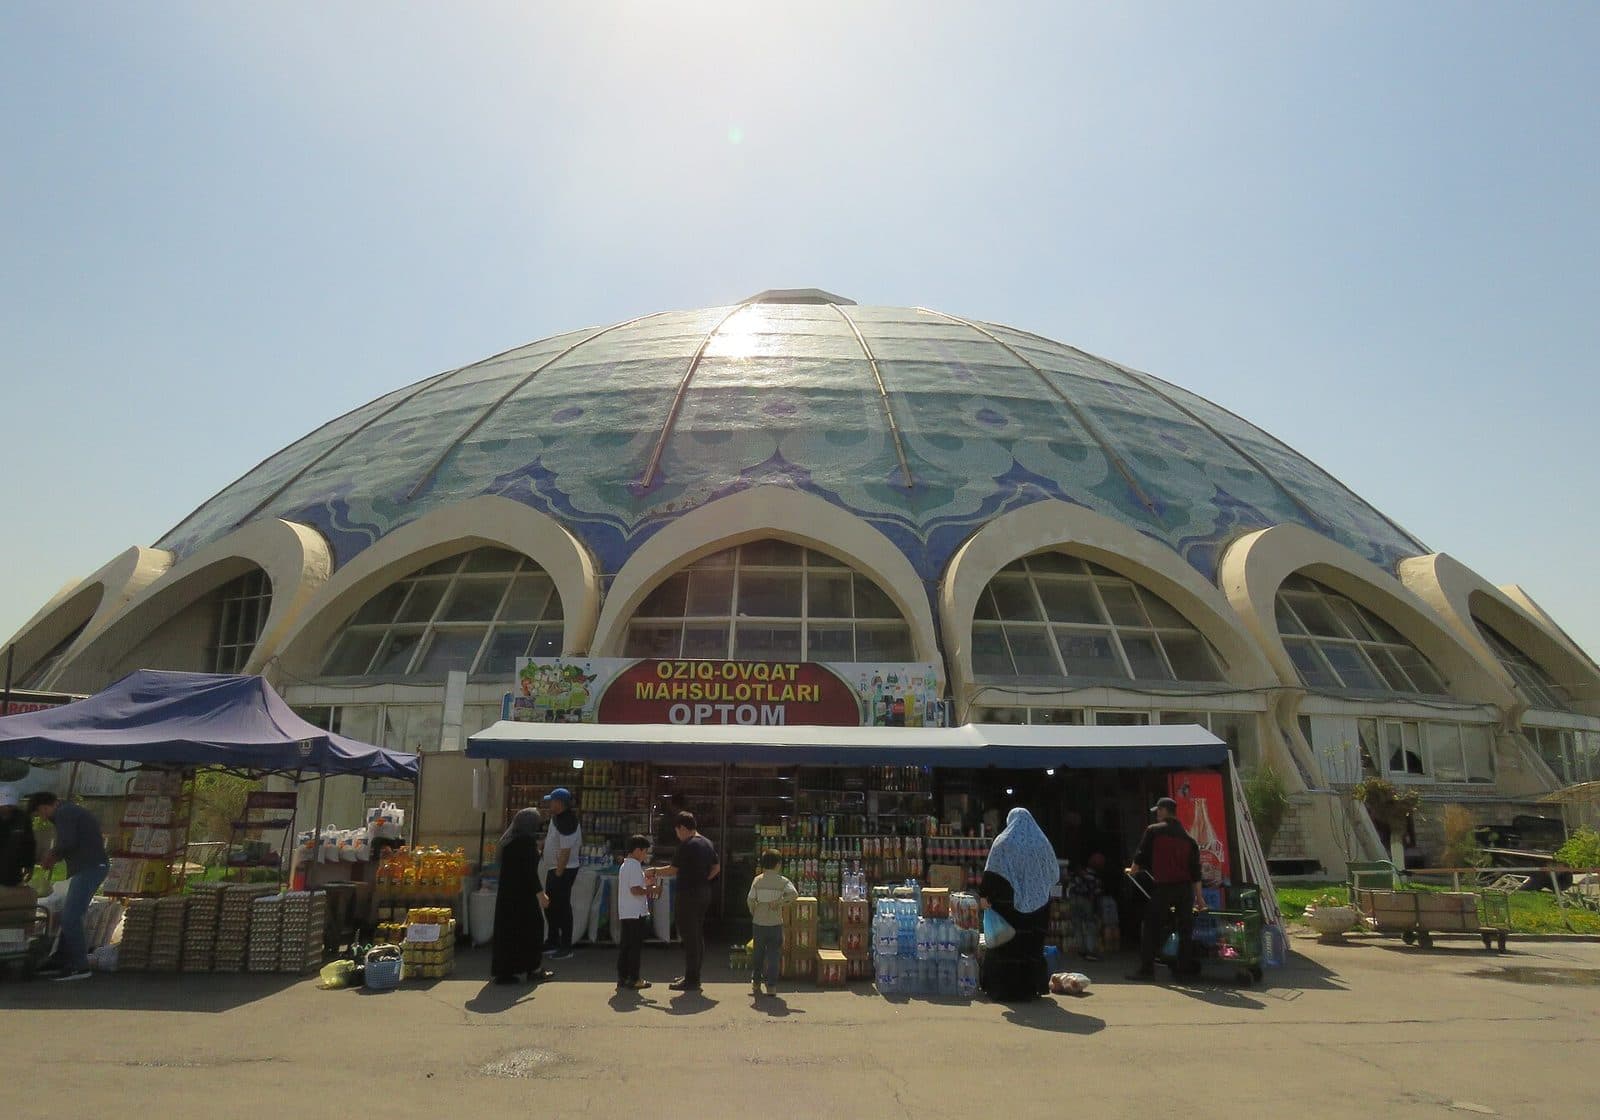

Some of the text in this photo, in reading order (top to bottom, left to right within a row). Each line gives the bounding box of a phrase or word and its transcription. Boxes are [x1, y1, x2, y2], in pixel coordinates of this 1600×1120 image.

[657, 661, 800, 681] OZIQ-OVQAT
[635, 681, 820, 702] MAHSULOTLARI
[668, 703, 785, 726] OPTOM
